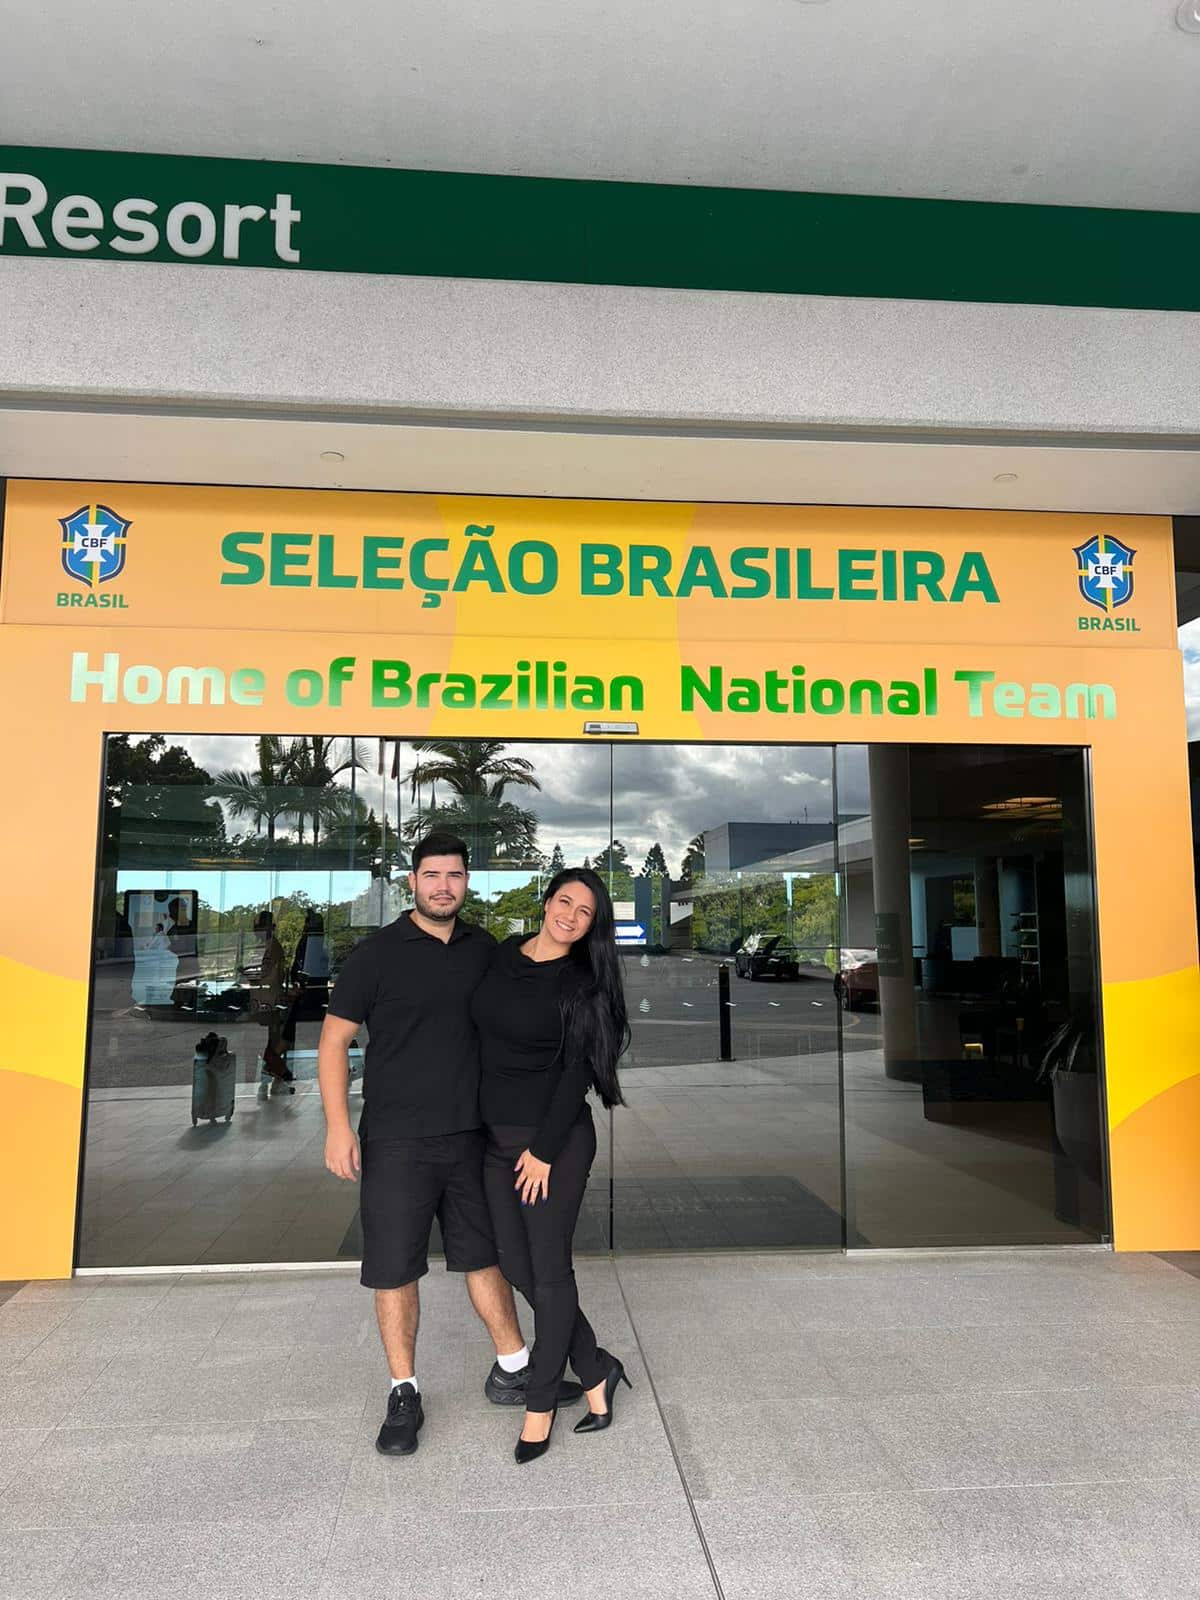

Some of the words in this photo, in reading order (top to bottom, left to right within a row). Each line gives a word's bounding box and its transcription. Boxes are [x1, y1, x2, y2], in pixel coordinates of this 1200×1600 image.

[0, 172, 301, 263] Resort
[81, 538, 108, 548] CBF
[220, 525, 559, 608] SELEÇÃO
[581, 543, 1000, 603] BRASILEIRA
[1094, 566, 1117, 575] CBF
[56, 592, 129, 608] BRASIL
[1078, 616, 1141, 631] BRASIL
[70, 652, 265, 706] Home
[285, 657, 356, 708] of
[371, 660, 644, 712] Brazilian
[680, 665, 938, 716] National
[954, 670, 1118, 720] Team
